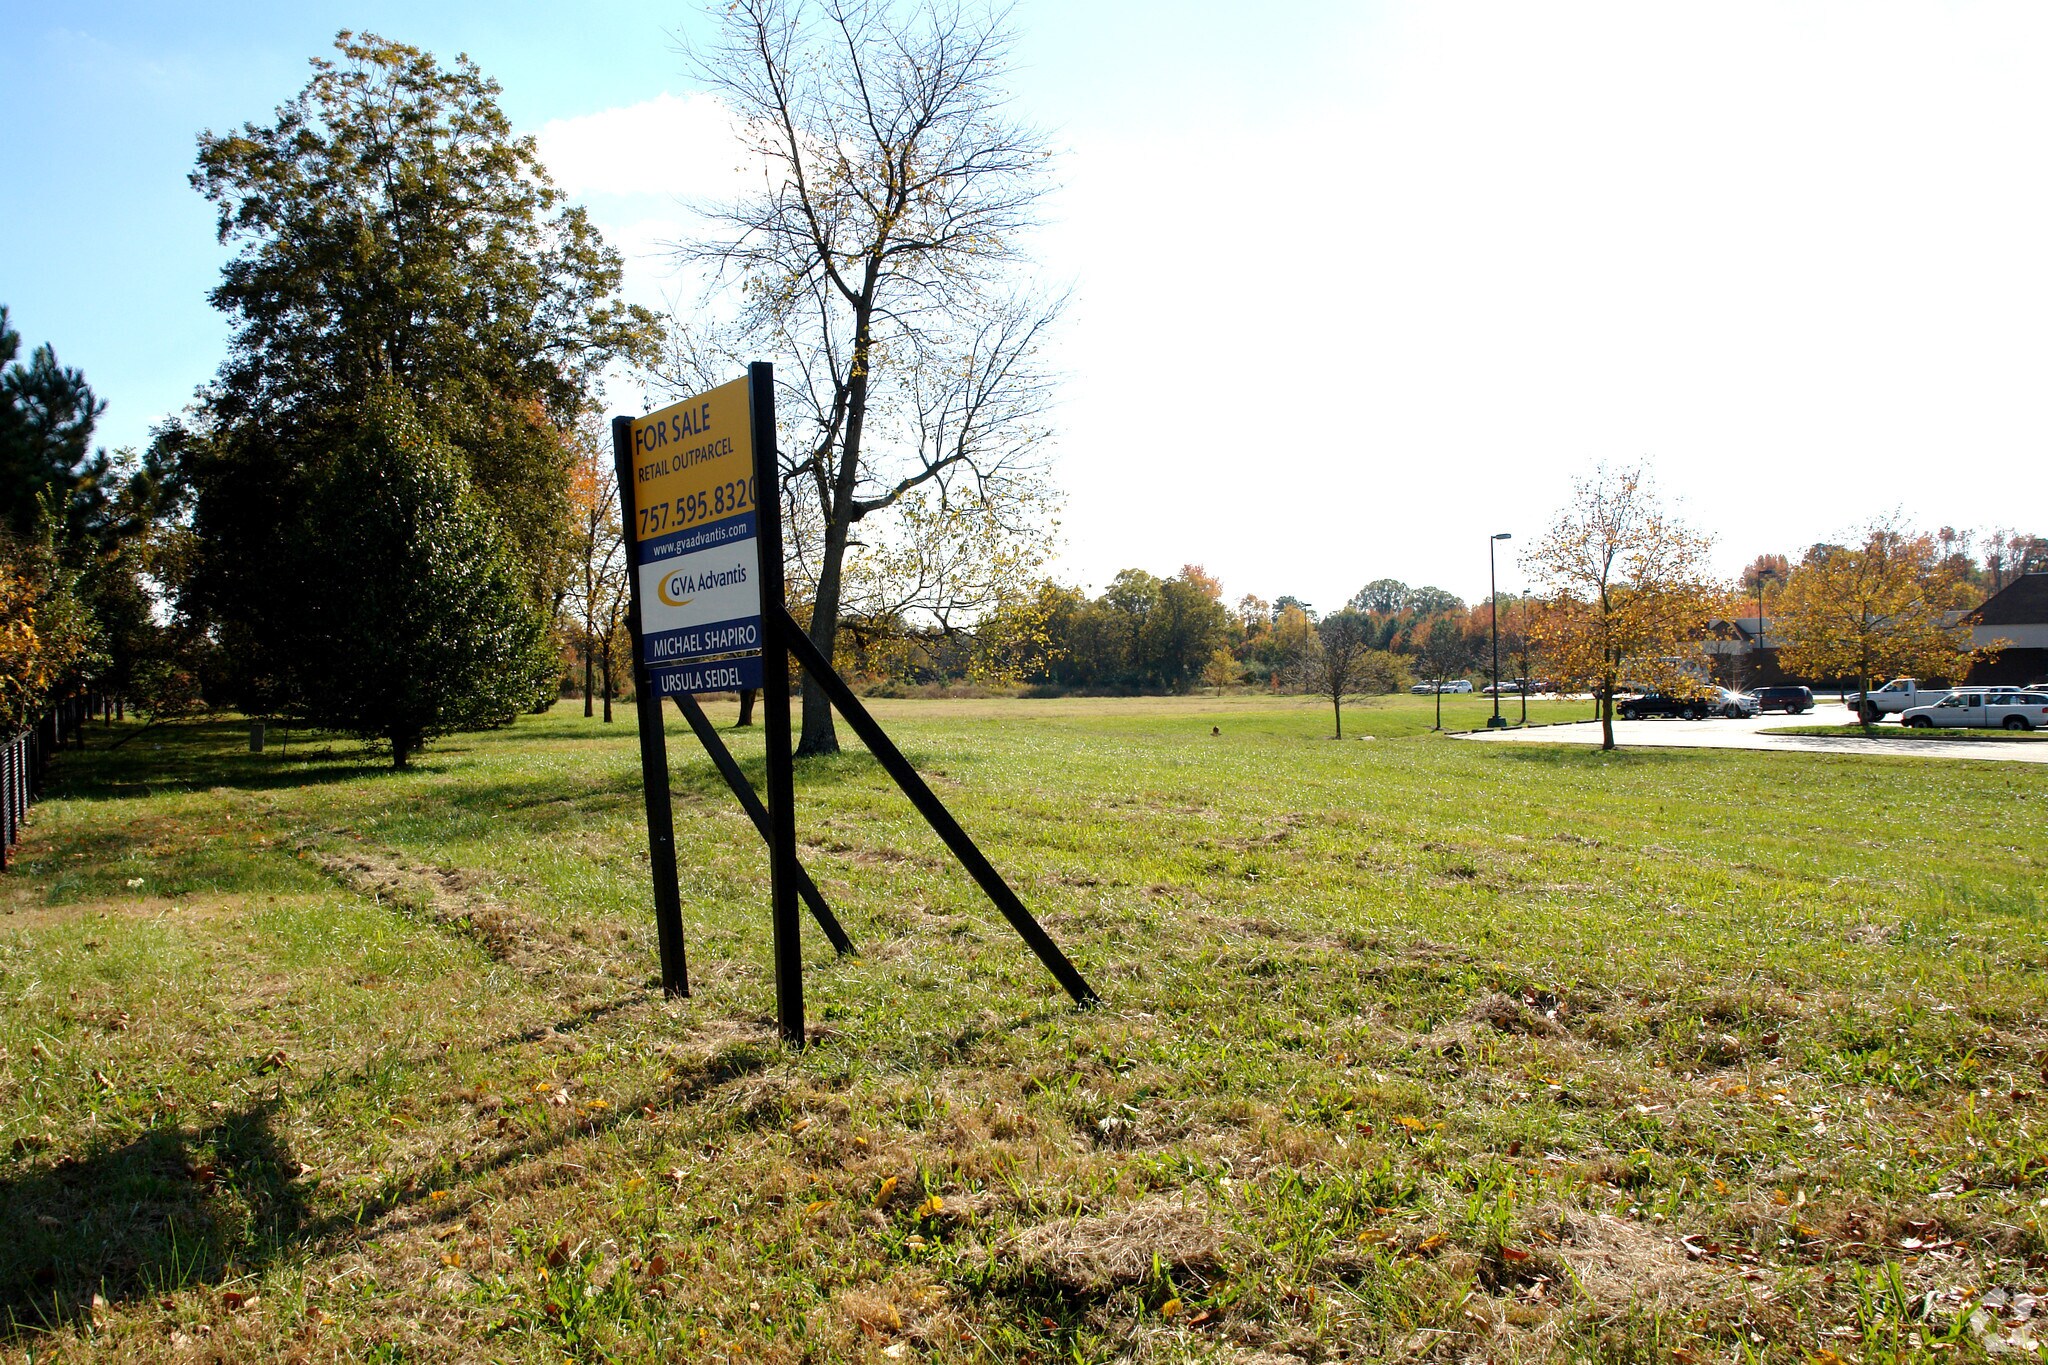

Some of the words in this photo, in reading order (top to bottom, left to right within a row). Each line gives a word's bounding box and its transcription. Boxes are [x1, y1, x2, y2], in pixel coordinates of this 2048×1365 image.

[635, 420, 668, 455] FOR
[672, 403, 710, 442] SALE
[638, 460, 670, 483] RETAIL
[672, 437, 734, 471] OUTPARCEL
[653, 523, 747, 556] www.gvaadvantis.com
[671, 576, 696, 596] GVA
[698, 563, 747, 591] Advantis
[654, 634, 702, 657] MICHAEL
[705, 625, 756, 650] SHAPIRO
[661, 672, 703, 692] URSULA
[705, 668, 742, 688] SEIDEL
